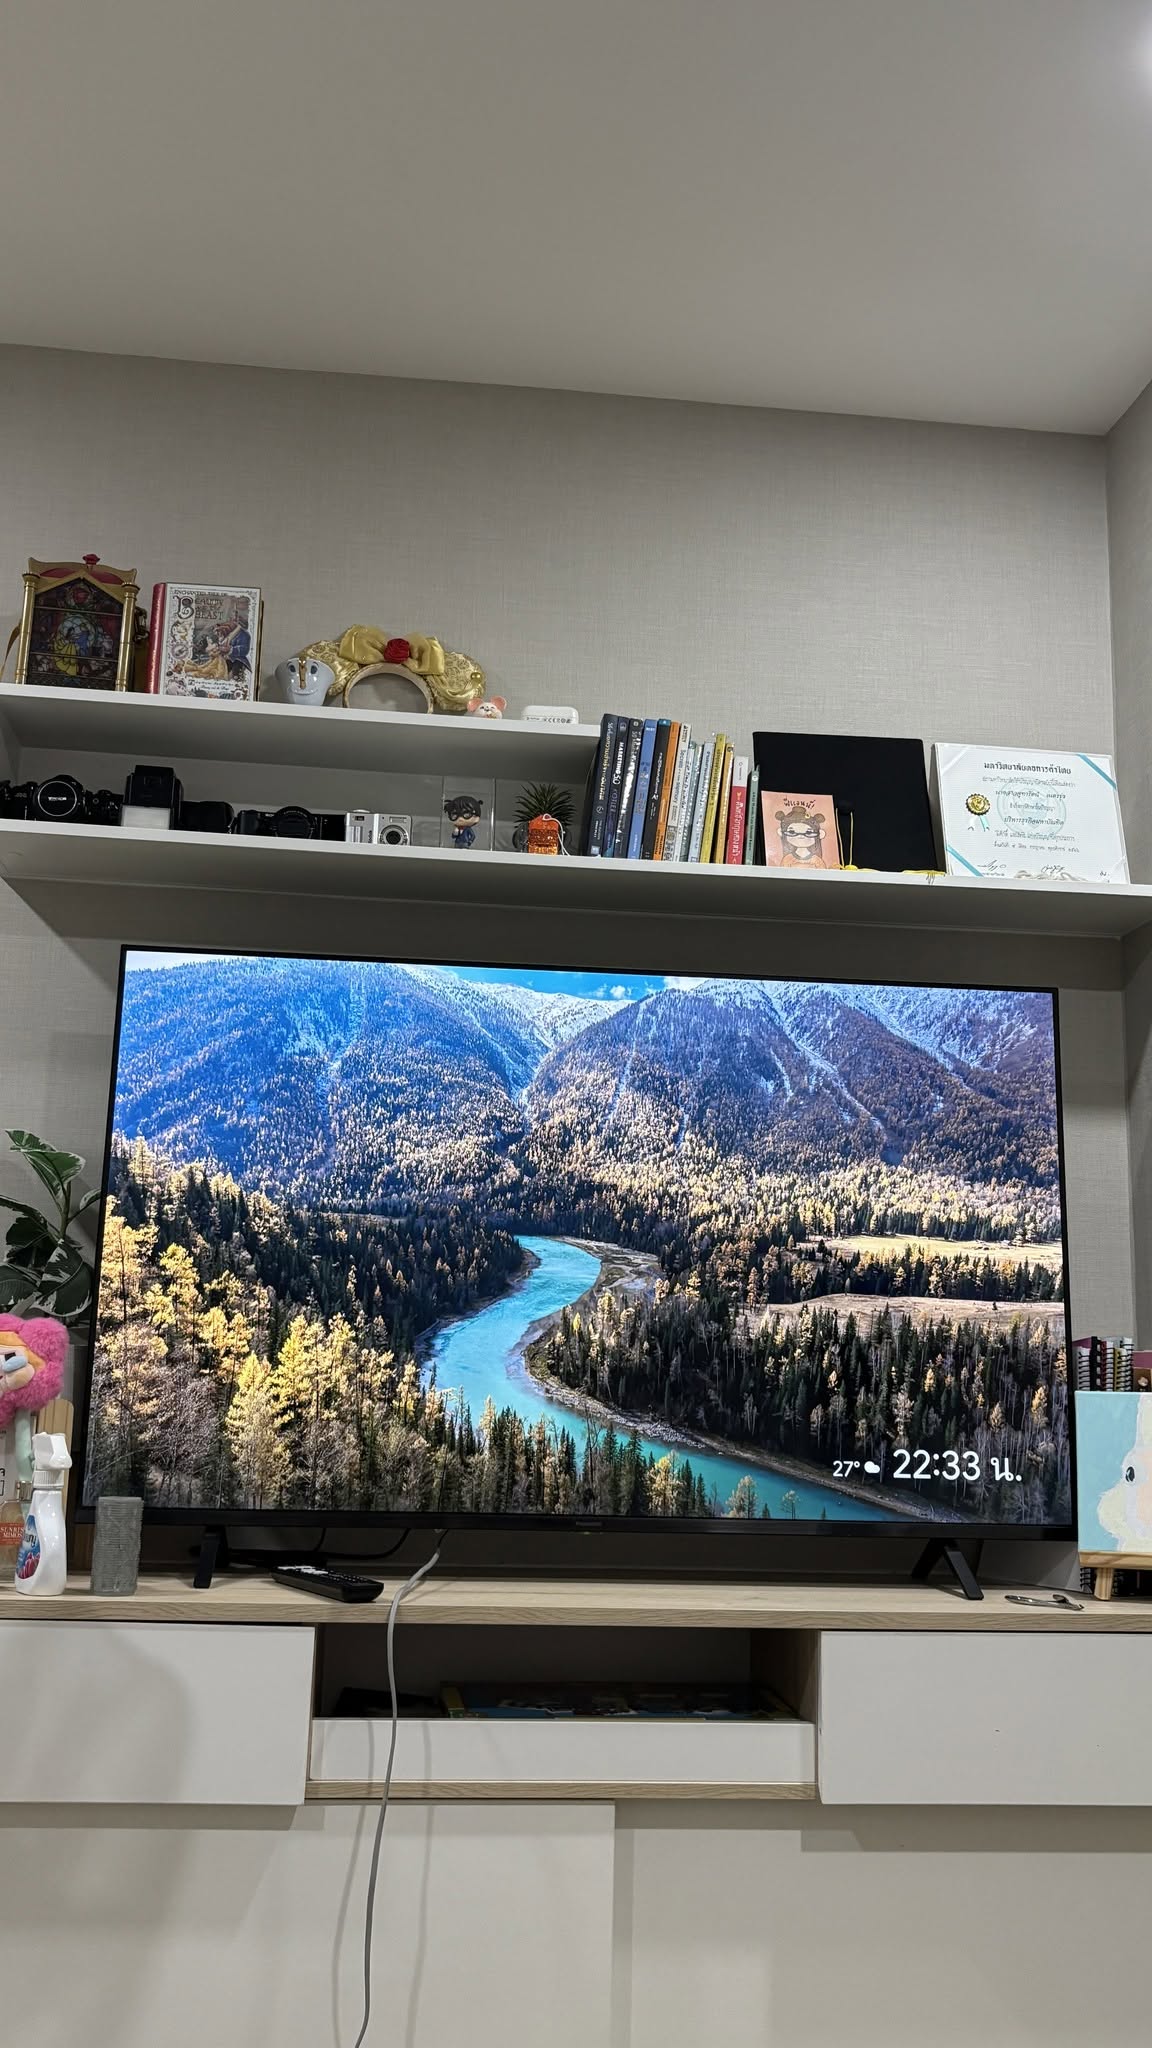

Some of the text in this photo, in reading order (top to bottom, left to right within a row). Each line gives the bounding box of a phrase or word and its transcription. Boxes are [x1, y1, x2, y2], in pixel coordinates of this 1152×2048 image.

[616, 742, 625, 774] MARKETING
[832, 1460, 861, 1478] 27°
[893, 1448, 1023, 1482] 22:33 น.
